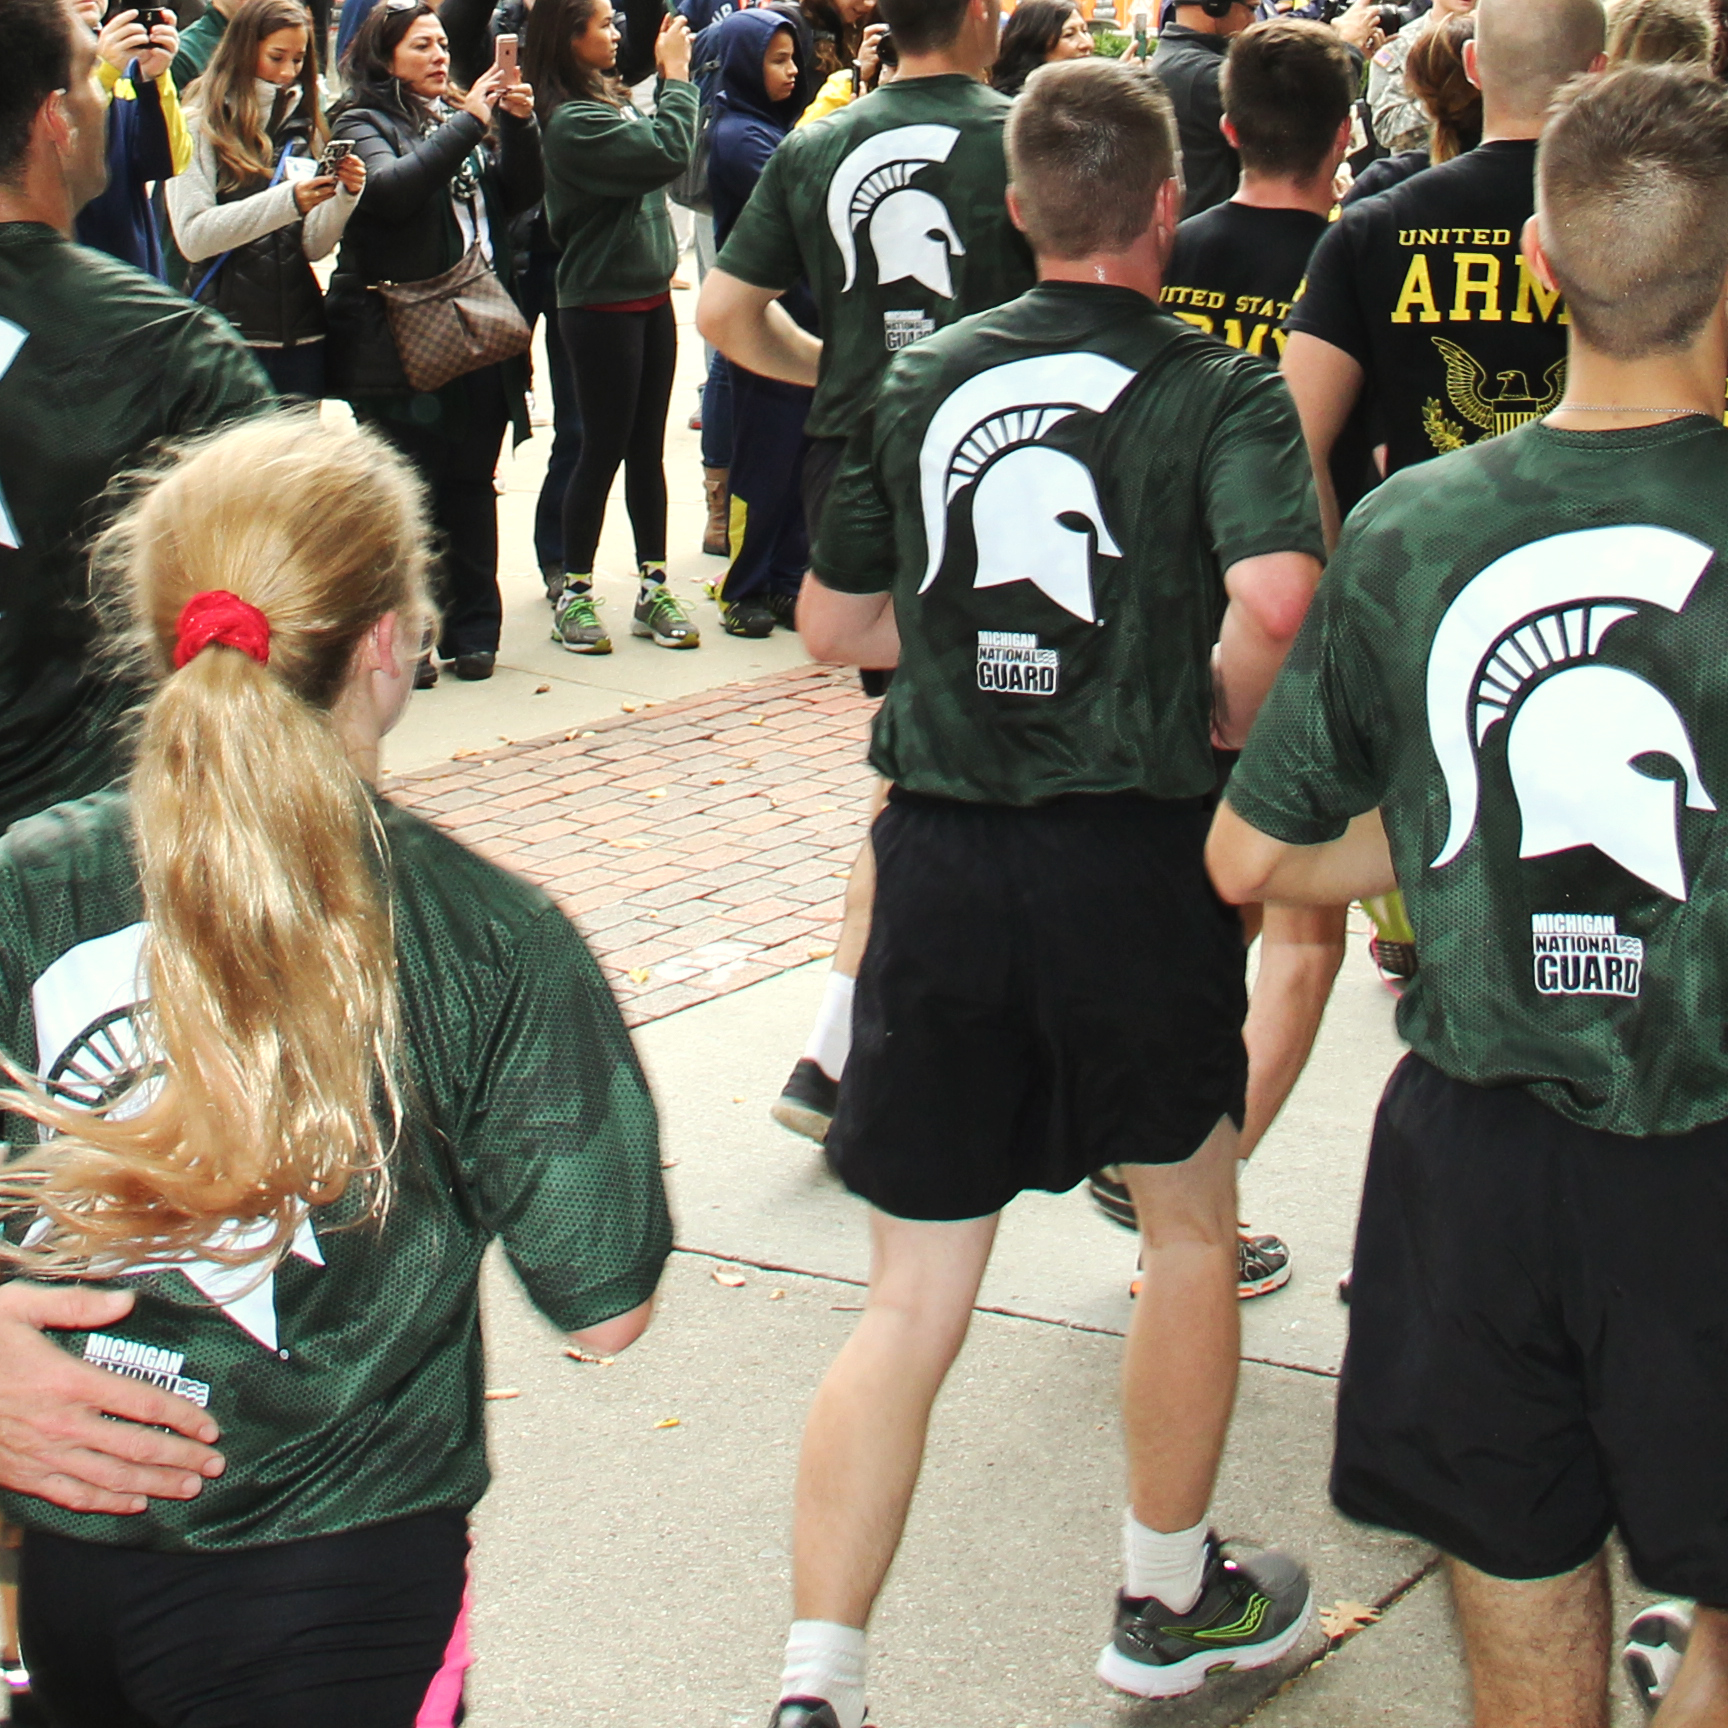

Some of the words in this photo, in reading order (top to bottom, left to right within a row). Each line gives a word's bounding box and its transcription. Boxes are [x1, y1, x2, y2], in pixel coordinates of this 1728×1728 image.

[1399, 228, 1511, 246] UNITED
[1391, 252, 1572, 325] ARM
[1159, 285, 1225, 309] ITED
[1235, 295, 1292, 320] STAT
[977, 631, 1036, 648] MICHIGAN
[978, 647, 1037, 663] NATIONAL
[978, 662, 1055, 692] GUARD
[1532, 913, 1615, 934] MICHIGAN
[1535, 936, 1621, 953] NATIONAL
[1536, 955, 1640, 994] GUARD
[85, 1332, 185, 1375] MICHIGAN
